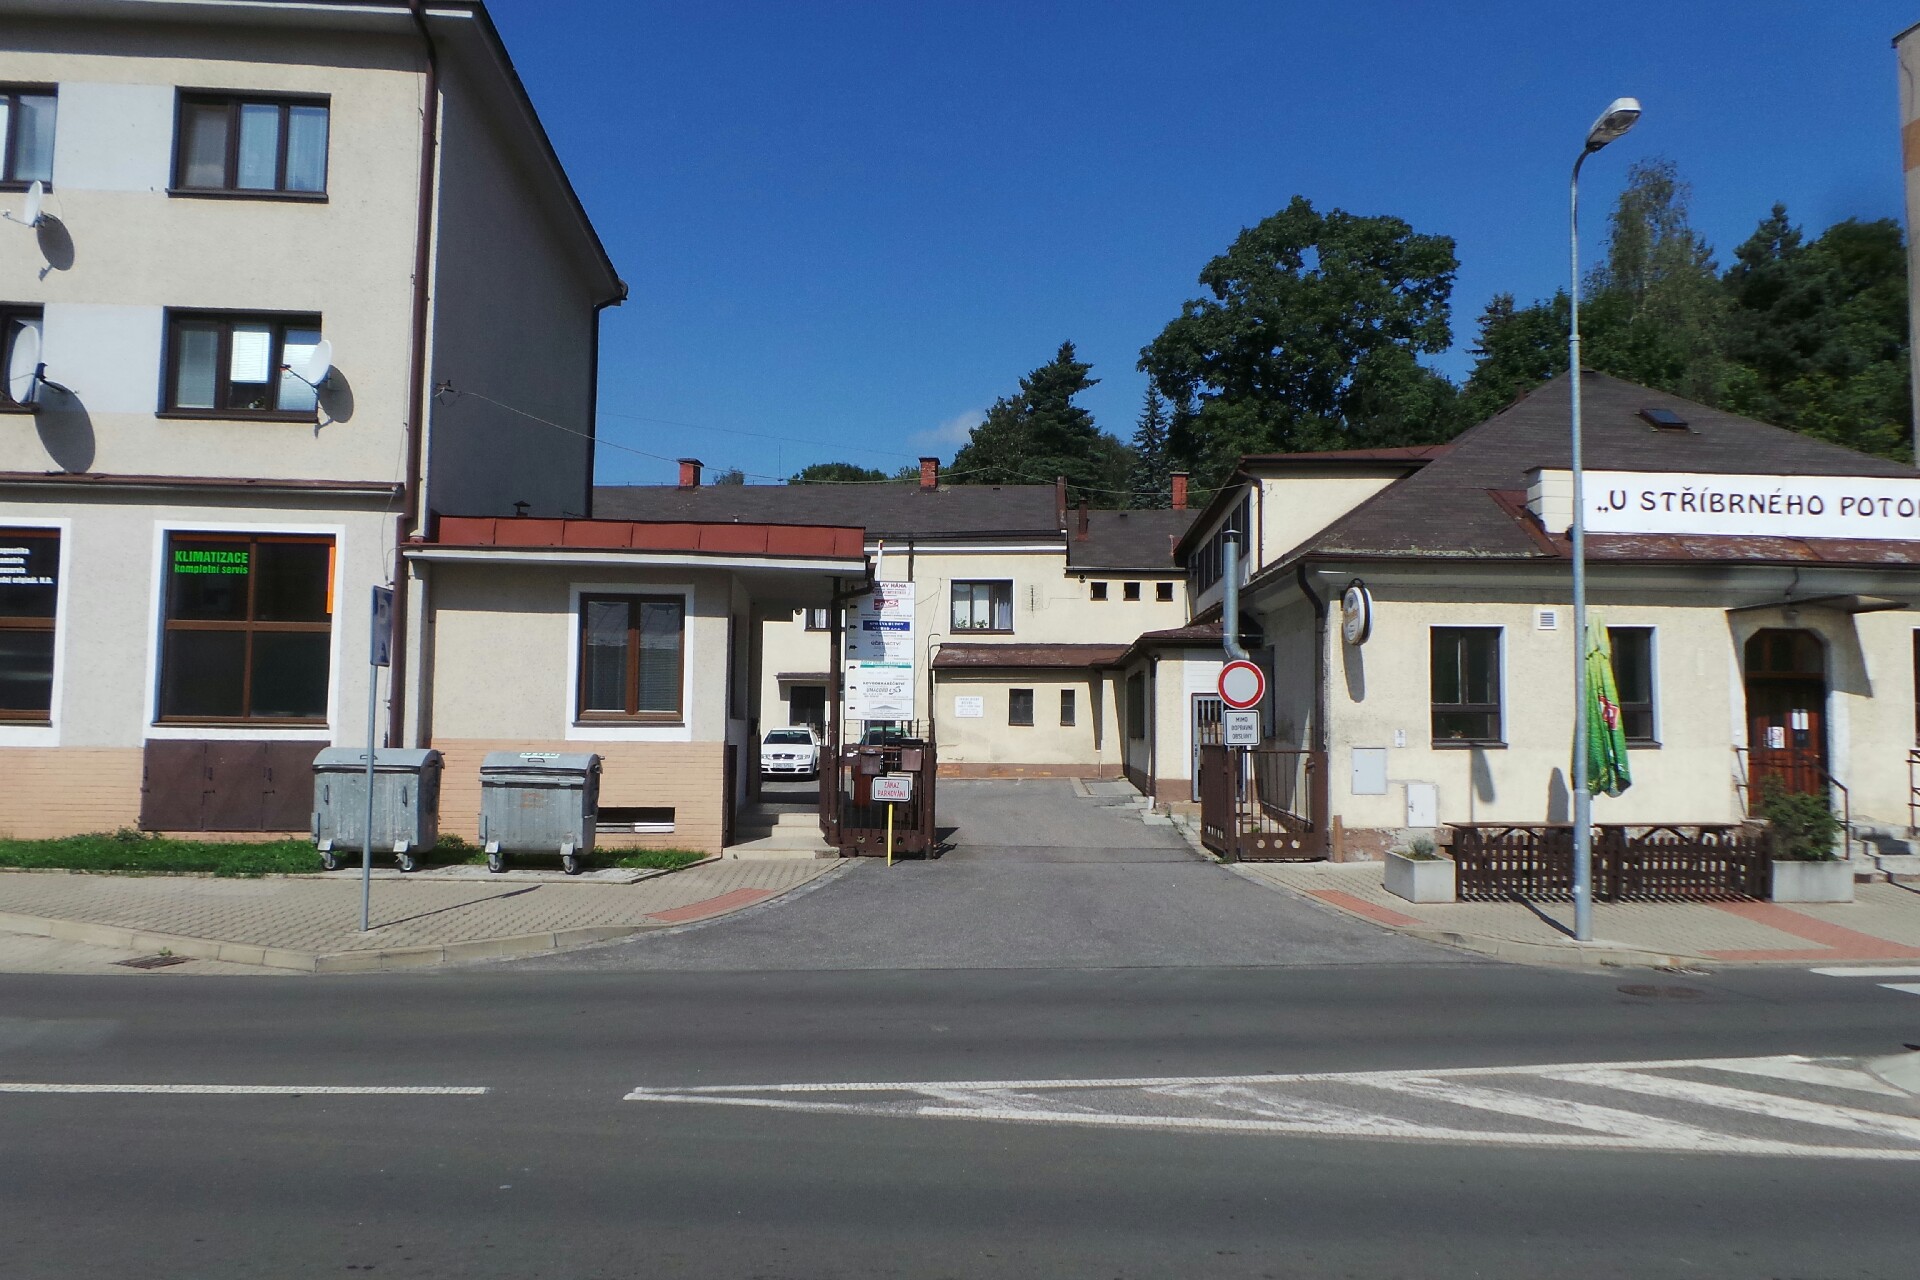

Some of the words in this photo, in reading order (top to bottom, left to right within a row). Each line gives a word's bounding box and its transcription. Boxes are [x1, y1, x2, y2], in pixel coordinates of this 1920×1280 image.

[1640, 486, 1824, 516] STŘÍBRNÉHO
[1841, 496, 1920, 518] POTO
[175, 551, 249, 564] KLIMATIZACE
[221, 565, 248, 574] servis
